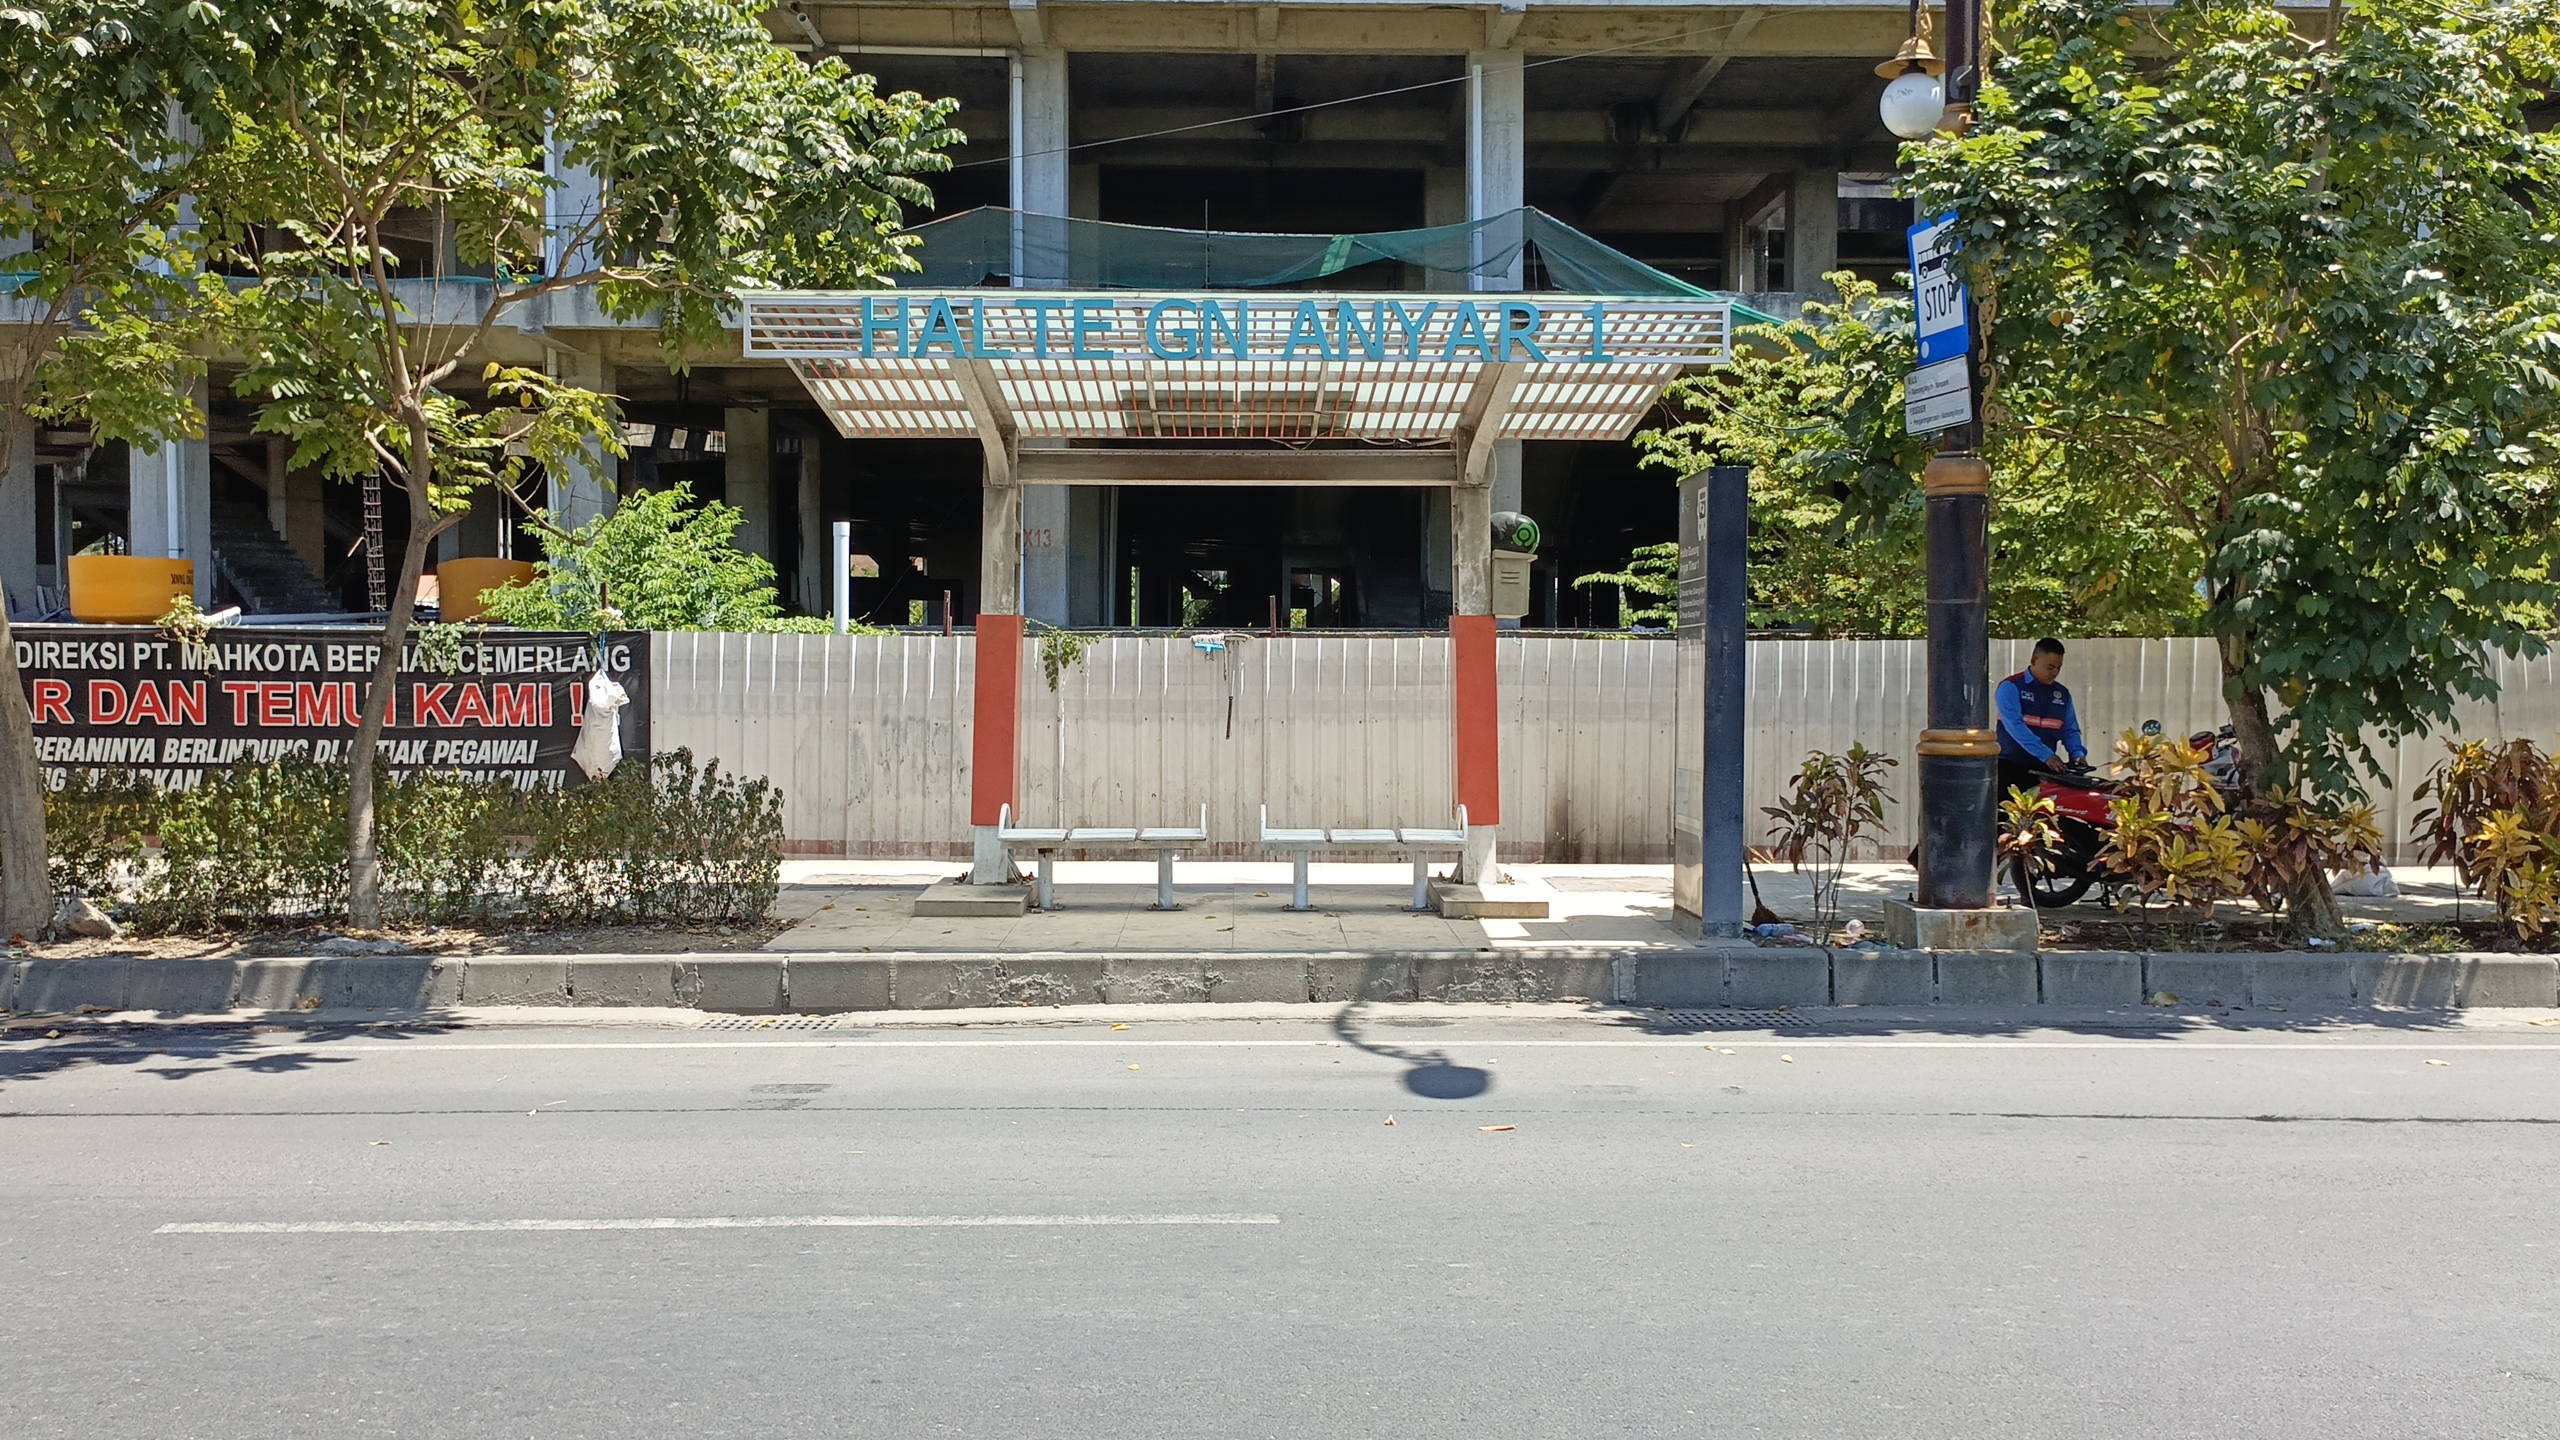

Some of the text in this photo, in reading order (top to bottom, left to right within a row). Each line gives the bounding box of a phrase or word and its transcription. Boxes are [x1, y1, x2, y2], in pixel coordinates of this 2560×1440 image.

[1925, 281, 1954, 321] STOP
[862, 297, 1614, 362] HALTE GN ANYAR 1
[1023, 528, 1052, 548] X13
[16, 641, 631, 674] DIREKSI PT. MAHKOTA BERIAN CEMERLANG
[88, 679, 207, 726] DAN
[413, 682, 553, 728] KAMI
[433, 740, 538, 765] PEGAWAI
